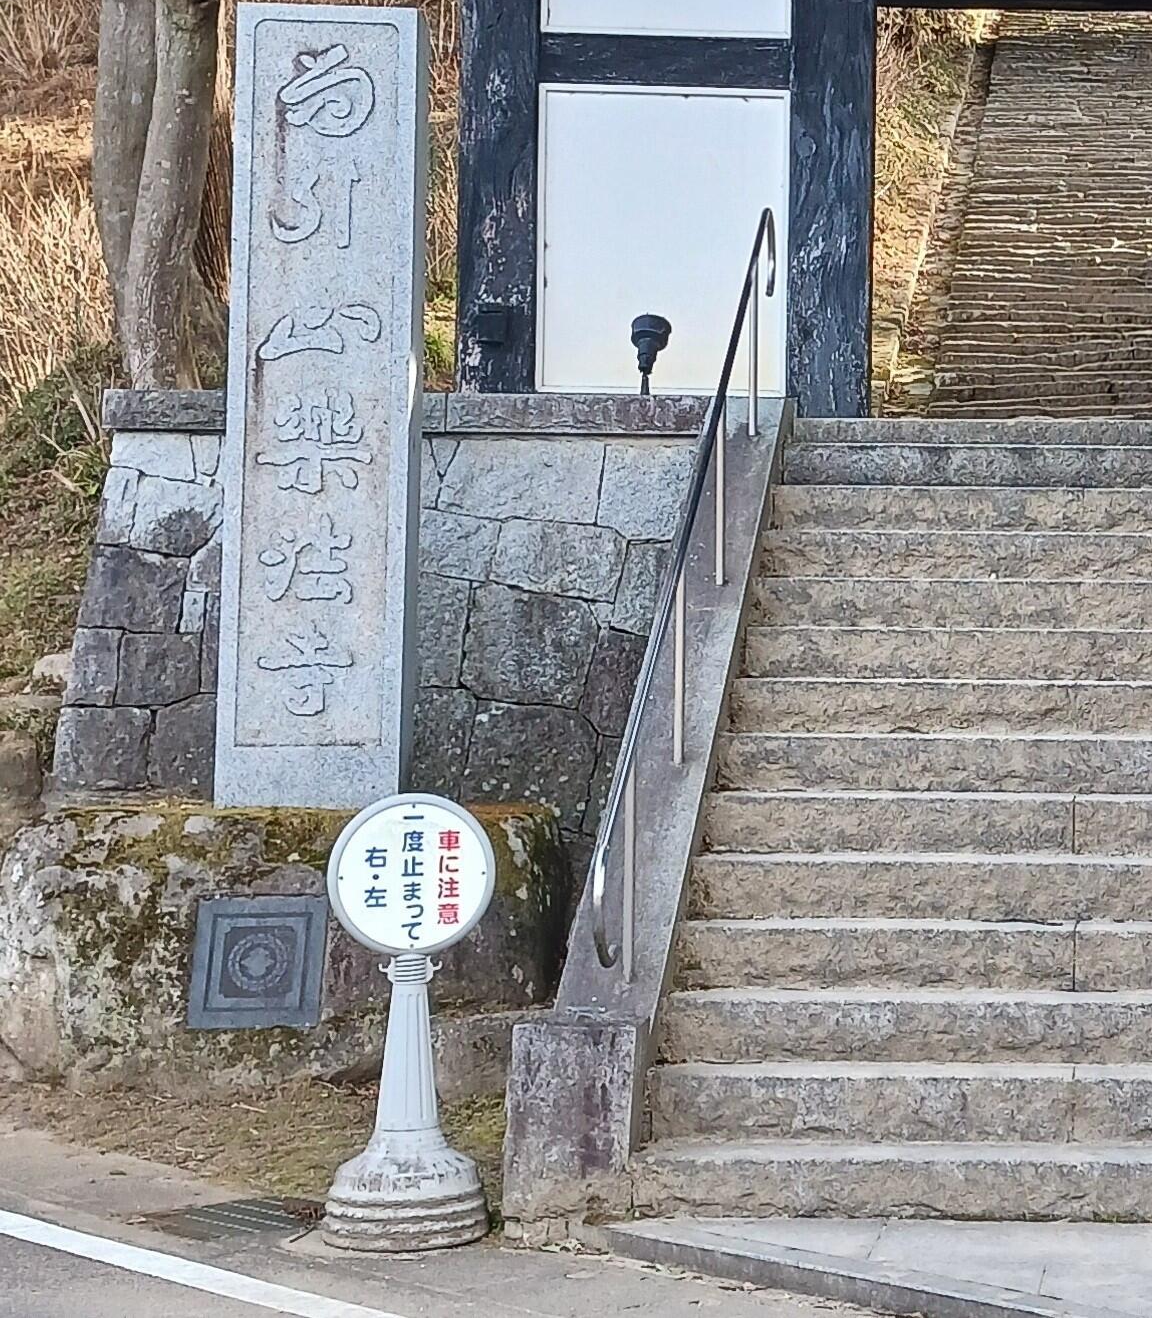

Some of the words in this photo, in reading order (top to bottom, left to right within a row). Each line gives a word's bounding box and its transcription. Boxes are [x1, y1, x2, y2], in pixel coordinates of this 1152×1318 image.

[364, 846, 388, 908] 右・左
[401, 815, 425, 940] 一度止まって
[437, 829, 461, 925] 車に注意
